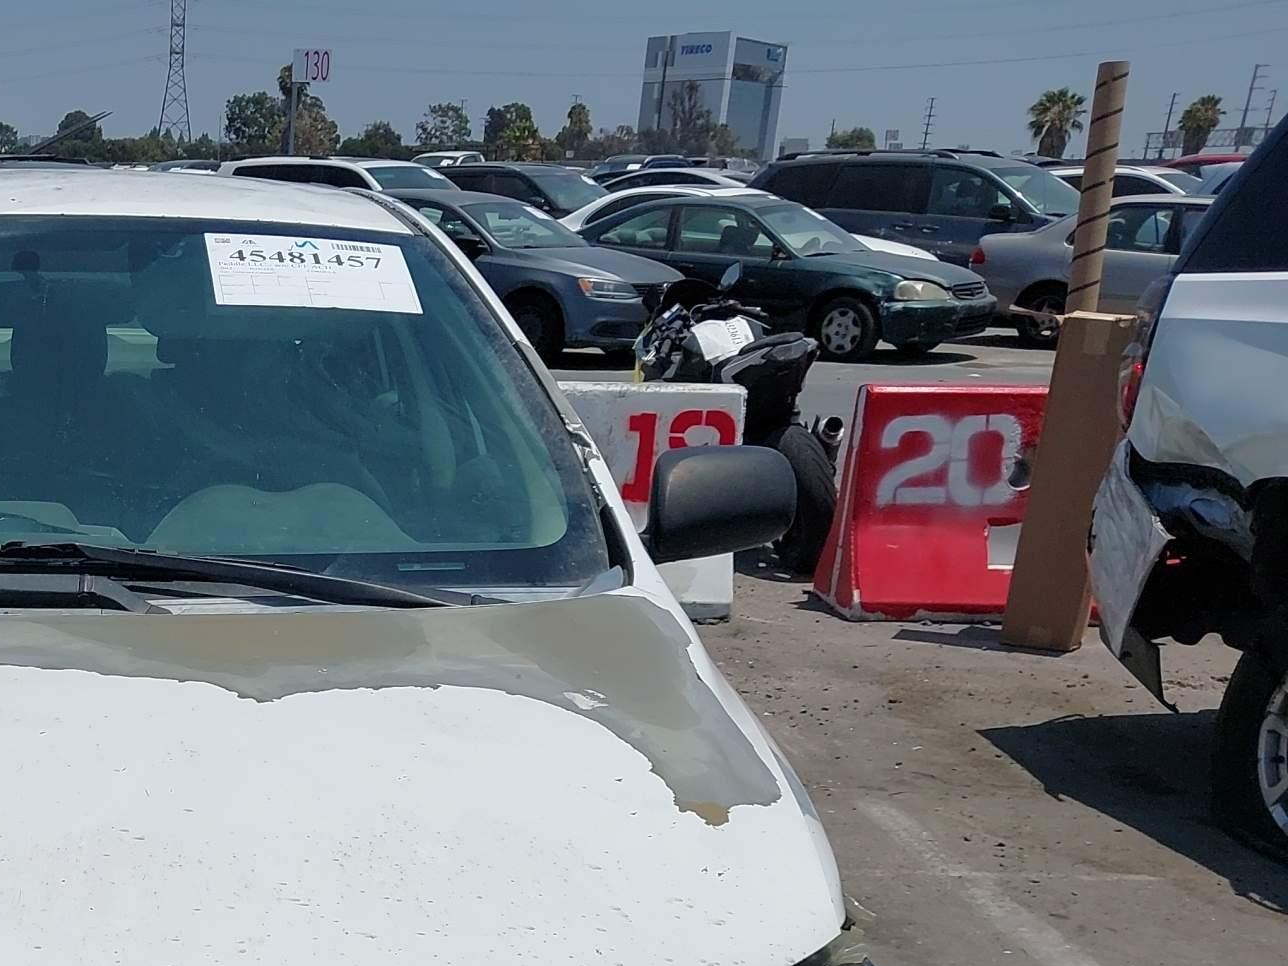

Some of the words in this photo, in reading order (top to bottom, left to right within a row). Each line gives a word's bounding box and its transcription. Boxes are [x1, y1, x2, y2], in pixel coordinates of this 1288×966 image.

[304, 50, 329, 81] 130
[229, 249, 382, 269] 45481457
[876, 414, 1022, 508] 20
